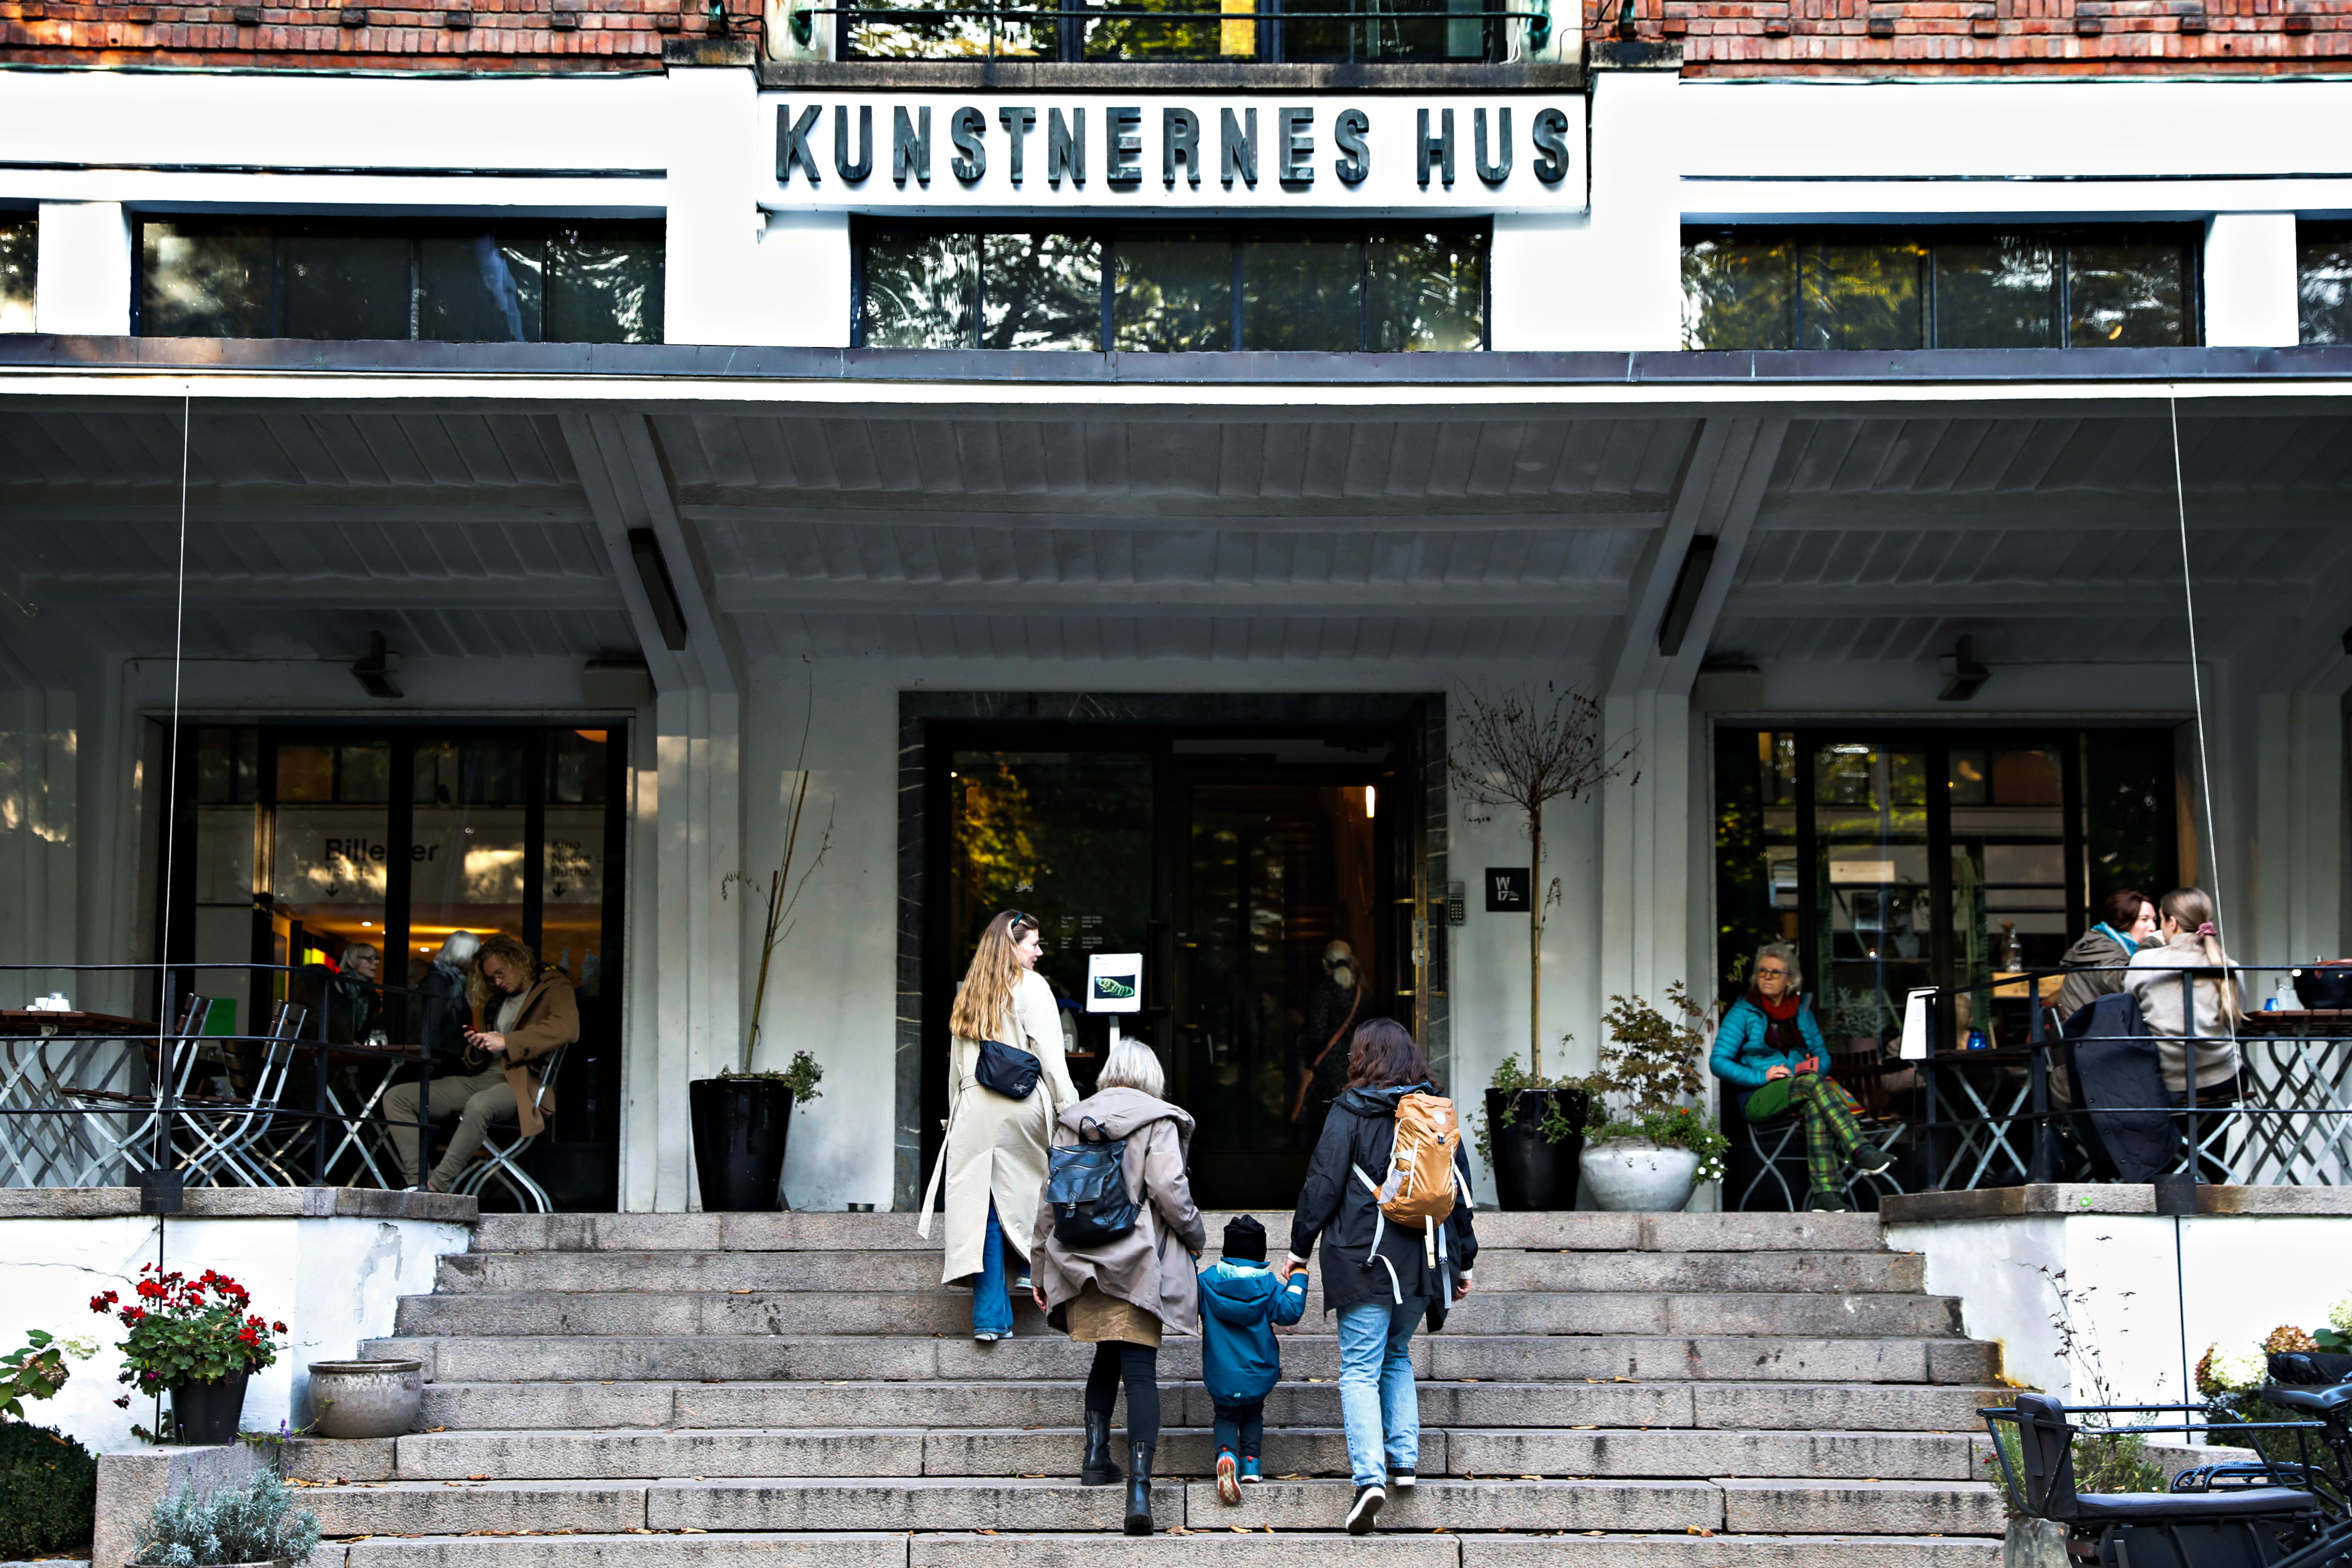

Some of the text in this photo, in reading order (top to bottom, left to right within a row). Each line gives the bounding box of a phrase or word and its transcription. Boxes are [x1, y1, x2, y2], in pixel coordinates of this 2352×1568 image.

[775, 104, 1569, 185] KUNSTNERNES HUS
[326, 838, 439, 861] Billeer
